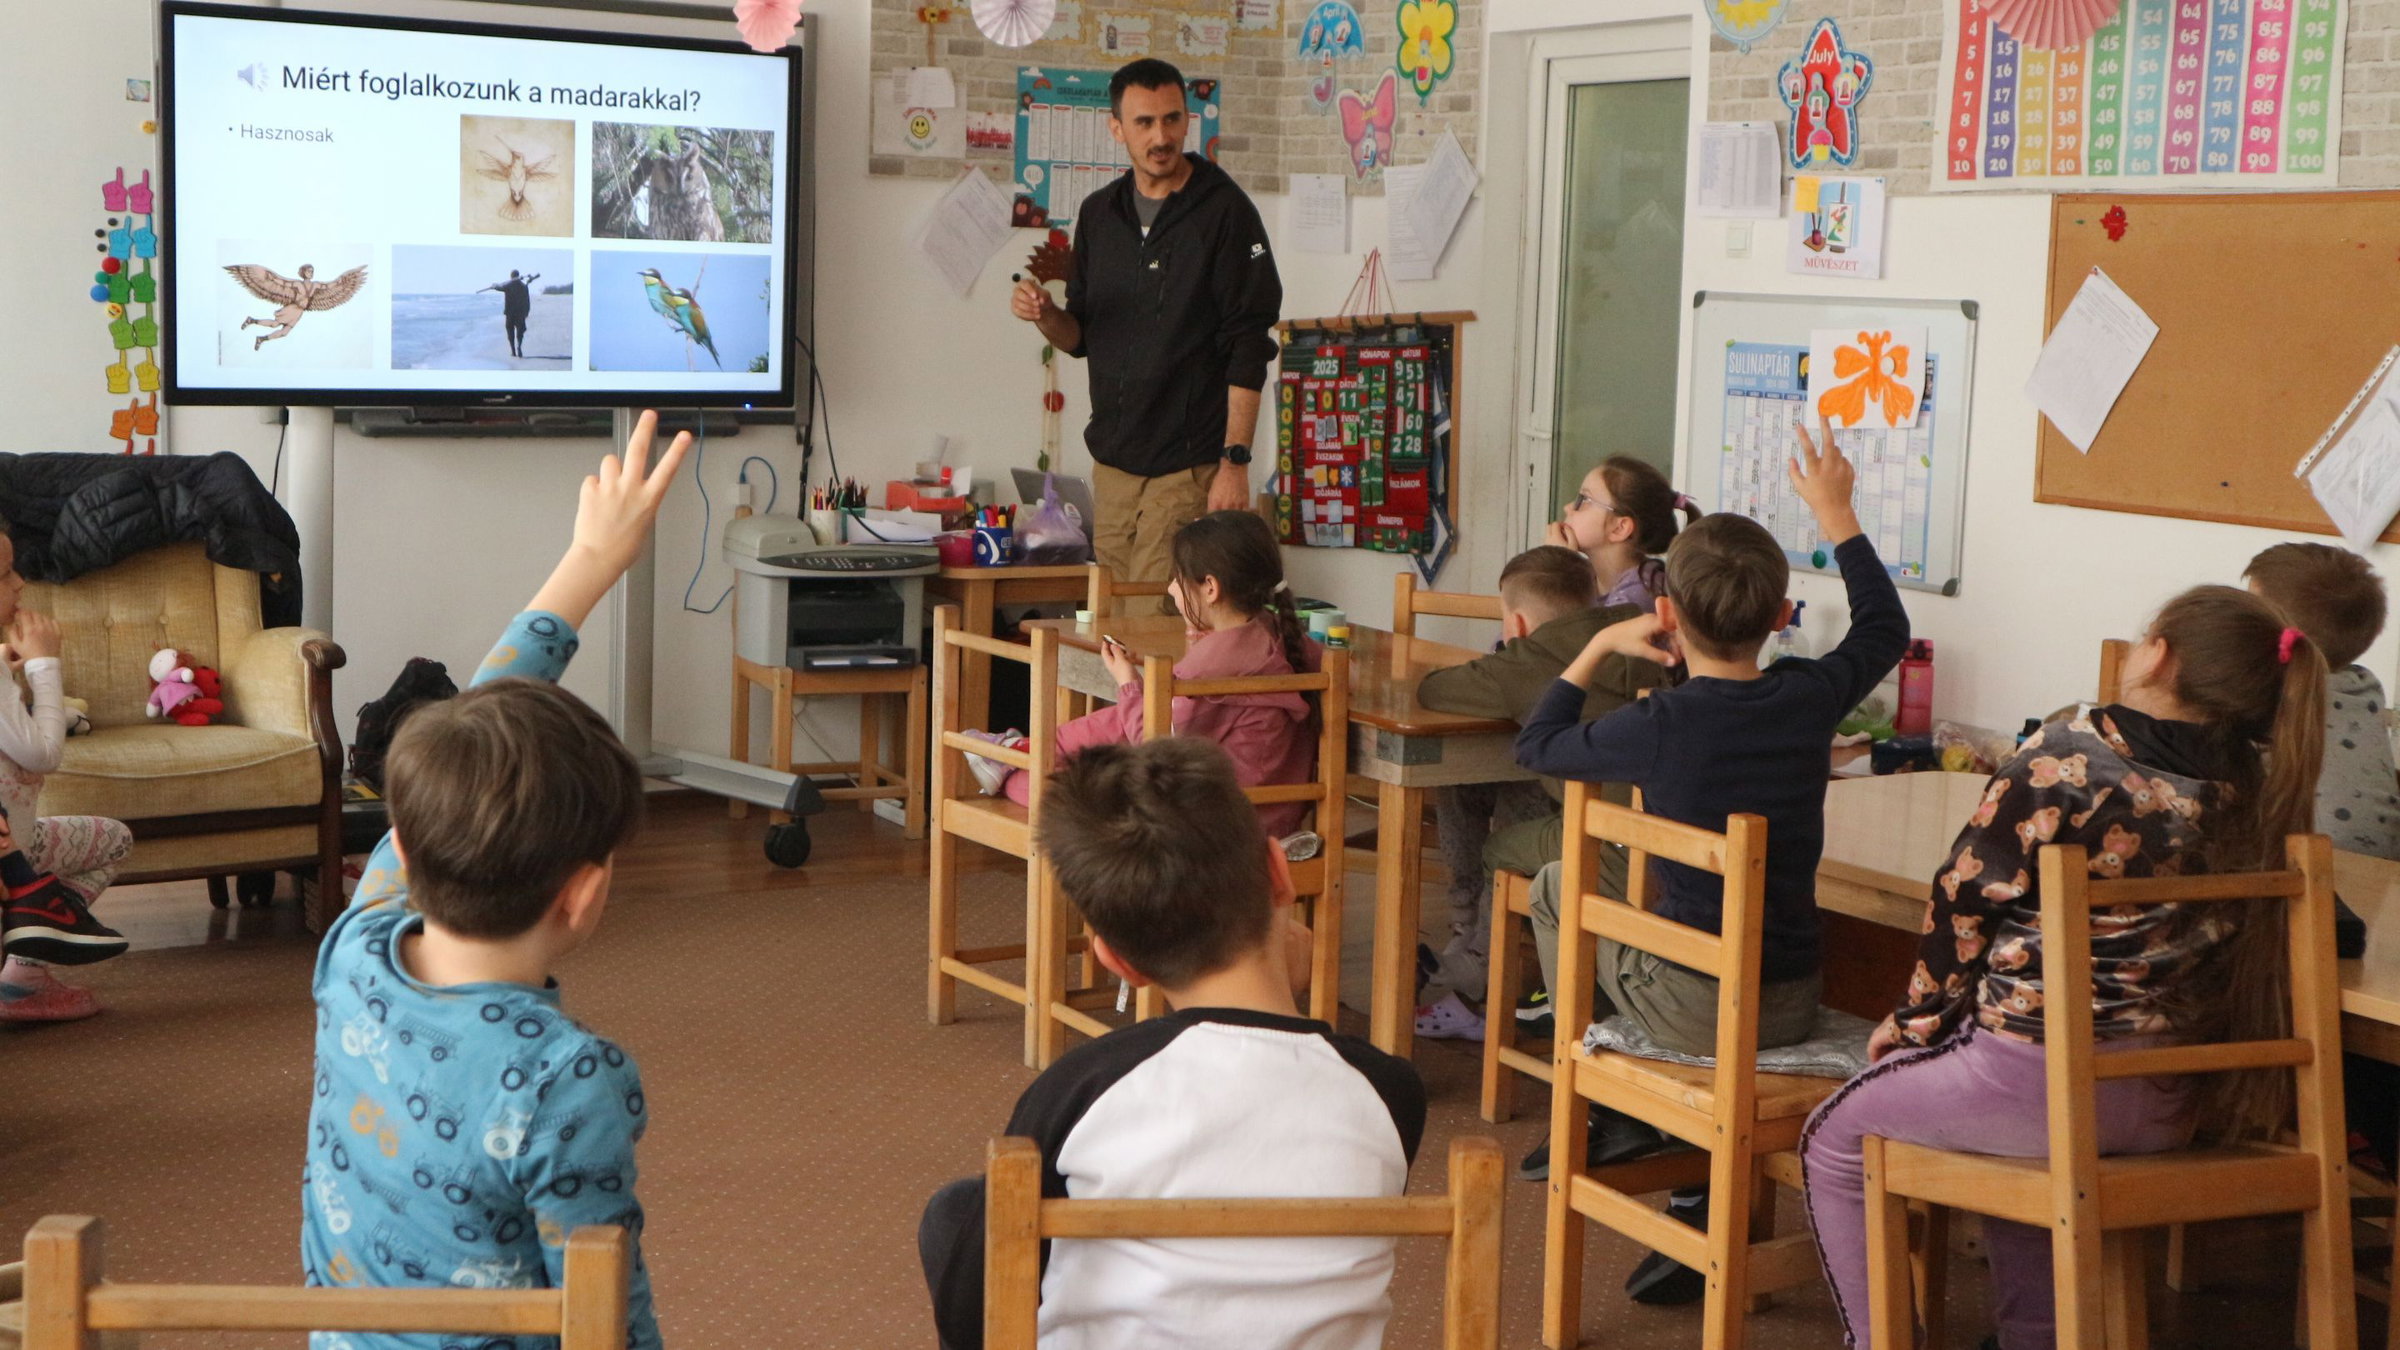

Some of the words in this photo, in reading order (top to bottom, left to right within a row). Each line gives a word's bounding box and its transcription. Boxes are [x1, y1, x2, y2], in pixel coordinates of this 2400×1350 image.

[1970, 0, 1979, 12] 3
[1969, 22, 1977, 36] 4
[2143, 9, 2162, 25] 54
[2182, 3, 2201, 19] 64
[2221, 0, 2239, 15] 74
[1967, 46, 1976, 59] 5
[1997, 42, 2013, 55] 15
[2099, 35, 2119, 51] 45
[2141, 35, 2161, 50] 55
[2180, 29, 2200, 45] 65
[2219, 24, 2238, 40] 75
[2258, 22, 2283, 38] 85
[2305, 22, 2328, 38] 95
[1810, 48, 1834, 66] July
[1965, 67, 1974, 80] 6
[1996, 64, 2012, 78] 16
[2027, 64, 2044, 77] 26
[2060, 61, 2078, 78] 36
[2098, 59, 2118, 76] 46
[2138, 59, 2158, 75] 56
[2178, 53, 2198, 69] 66
[2216, 48, 2236, 65] 76
[2256, 47, 2280, 62] 86
[2303, 47, 2325, 65] 96
[283, 65, 351, 92] Miért
[359, 69, 521, 102] foglalkozunk
[528, 85, 542, 103] a
[551, 84, 701, 112] madarakkal?
[1963, 91, 1972, 106] 7
[1994, 88, 2011, 102] 17
[2026, 87, 2042, 101] 27
[2058, 86, 2077, 102] 37
[2097, 85, 2116, 100] 47
[2136, 85, 2156, 100] 57
[2176, 80, 2196, 96] 67
[2213, 75, 2234, 92] 77
[2254, 73, 2278, 91] 87
[2299, 75, 2322, 91] 97
[1961, 114, 1970, 126] 8
[1992, 111, 2009, 125] 18
[2025, 111, 2042, 124] 28
[2058, 109, 2076, 125] 38
[2096, 108, 2115, 125] 48
[2134, 108, 2154, 125] 58
[2174, 104, 2194, 119] 68
[2212, 100, 2232, 117] 78
[2251, 100, 2274, 115] 88
[2297, 100, 2320, 117] 98
[240, 123, 334, 143] Hasznosak
[1958, 138, 1967, 151] 9
[1992, 135, 2010, 149] 19
[2025, 135, 2042, 148] 29
[2057, 134, 2076, 150] 39
[2094, 134, 2114, 150] 49
[2133, 134, 2153, 150] 59
[2172, 130, 2192, 146] 69
[2210, 127, 2230, 143] 79
[2250, 126, 2272, 143] 89
[2296, 128, 2319, 144] 99
[1954, 160, 1970, 173] 10
[1990, 159, 2007, 171] 20
[2023, 159, 2041, 172] 30
[2057, 159, 2075, 173] 40
[2094, 159, 2112, 173] 50
[2131, 159, 2151, 172] 60
[2170, 157, 2190, 171] 70
[2208, 152, 2228, 166] 80
[2247, 153, 2270, 169] 90
[2290, 155, 2322, 168] 100
[1360, 349, 1390, 359] HÓNAPOK
[1729, 350, 1790, 377] SULINAPTÁR
[1313, 359, 1339, 375] 2025
[1395, 360, 1403, 376] 9
[1406, 363, 1414, 380] 5
[1416, 363, 1424, 380] 3
[1406, 391, 1415, 409] 7
